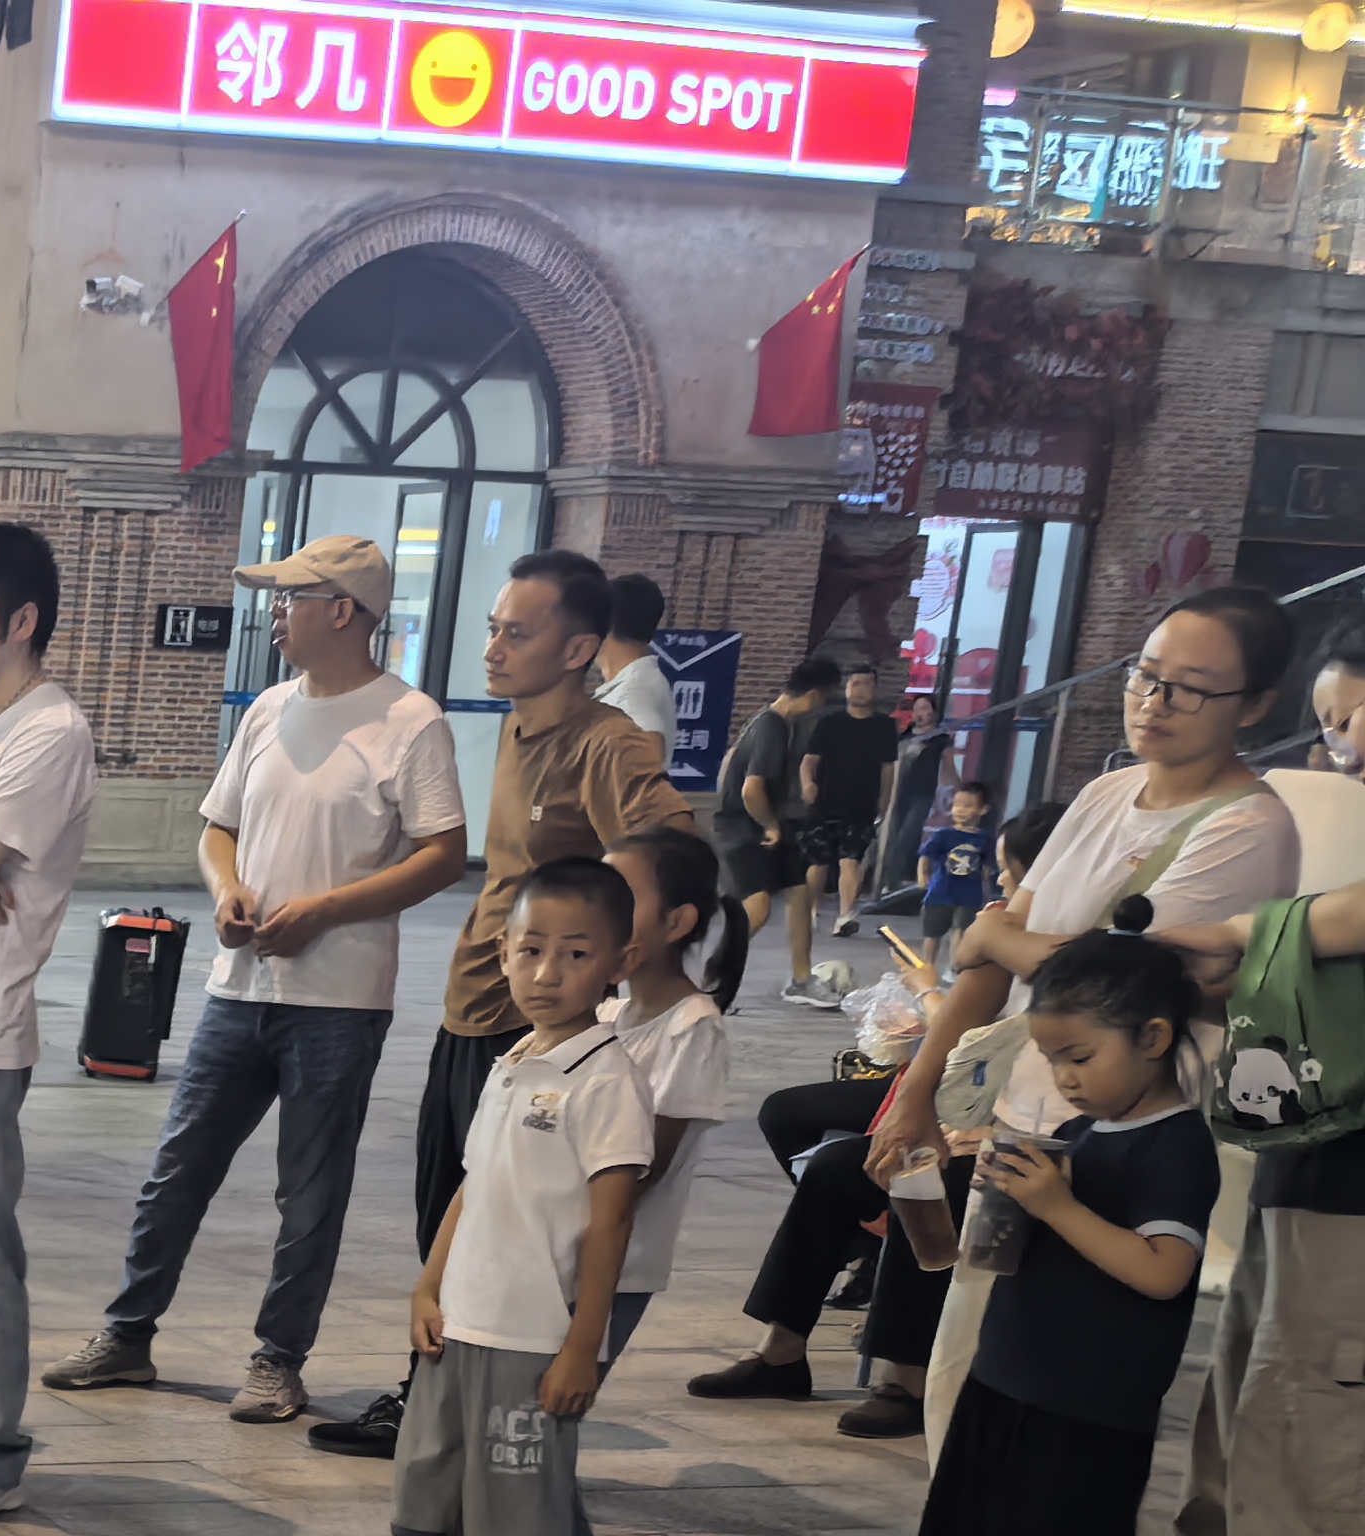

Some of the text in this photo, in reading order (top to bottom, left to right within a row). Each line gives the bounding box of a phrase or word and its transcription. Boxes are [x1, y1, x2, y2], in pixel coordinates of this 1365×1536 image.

[215, 21, 367, 112] 邻几
[523, 61, 793, 133] GOOD SPOT
